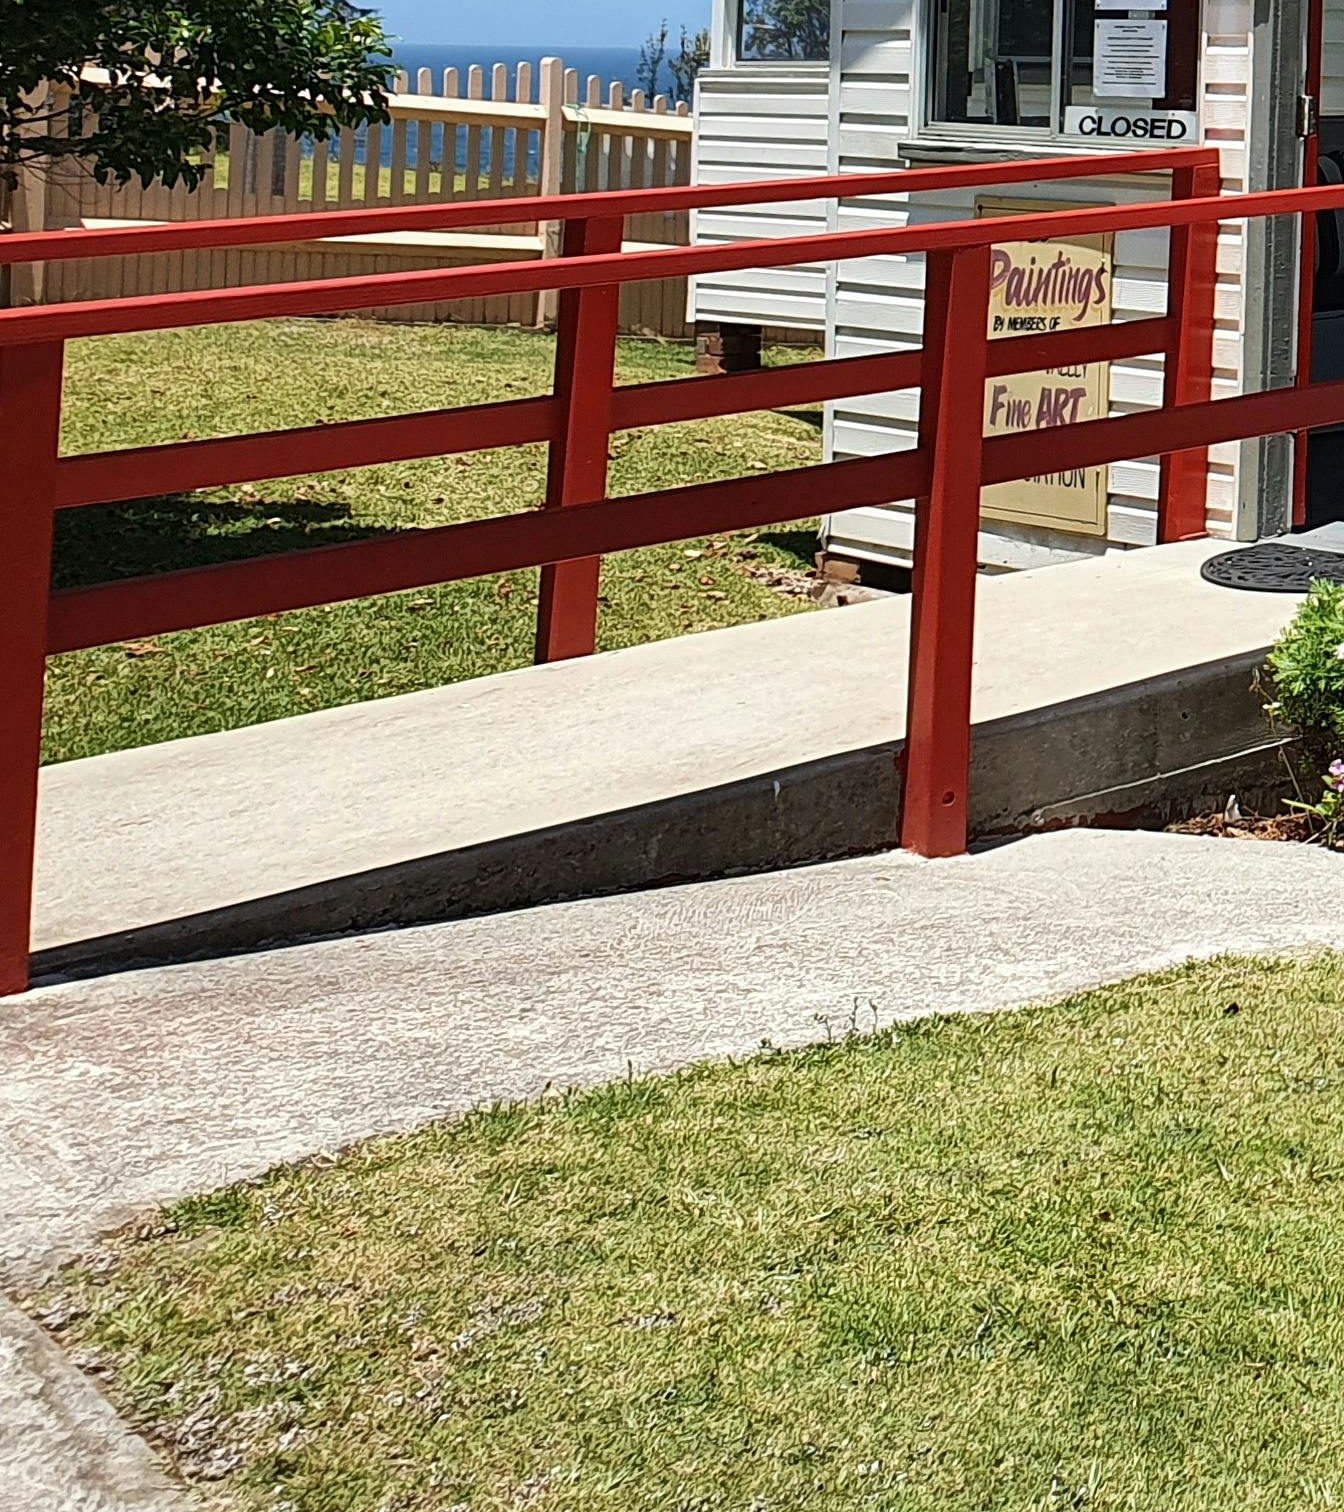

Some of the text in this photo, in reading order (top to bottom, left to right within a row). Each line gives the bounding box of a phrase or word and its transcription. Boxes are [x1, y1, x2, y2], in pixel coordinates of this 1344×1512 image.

[1079, 115, 1187, 139] CLOSED
[991, 249, 1108, 322] Paintings
[1007, 316, 1047, 331] MEMBERS
[1049, 316, 1061, 330] OF
[990, 384, 1087, 429] Fine ART
